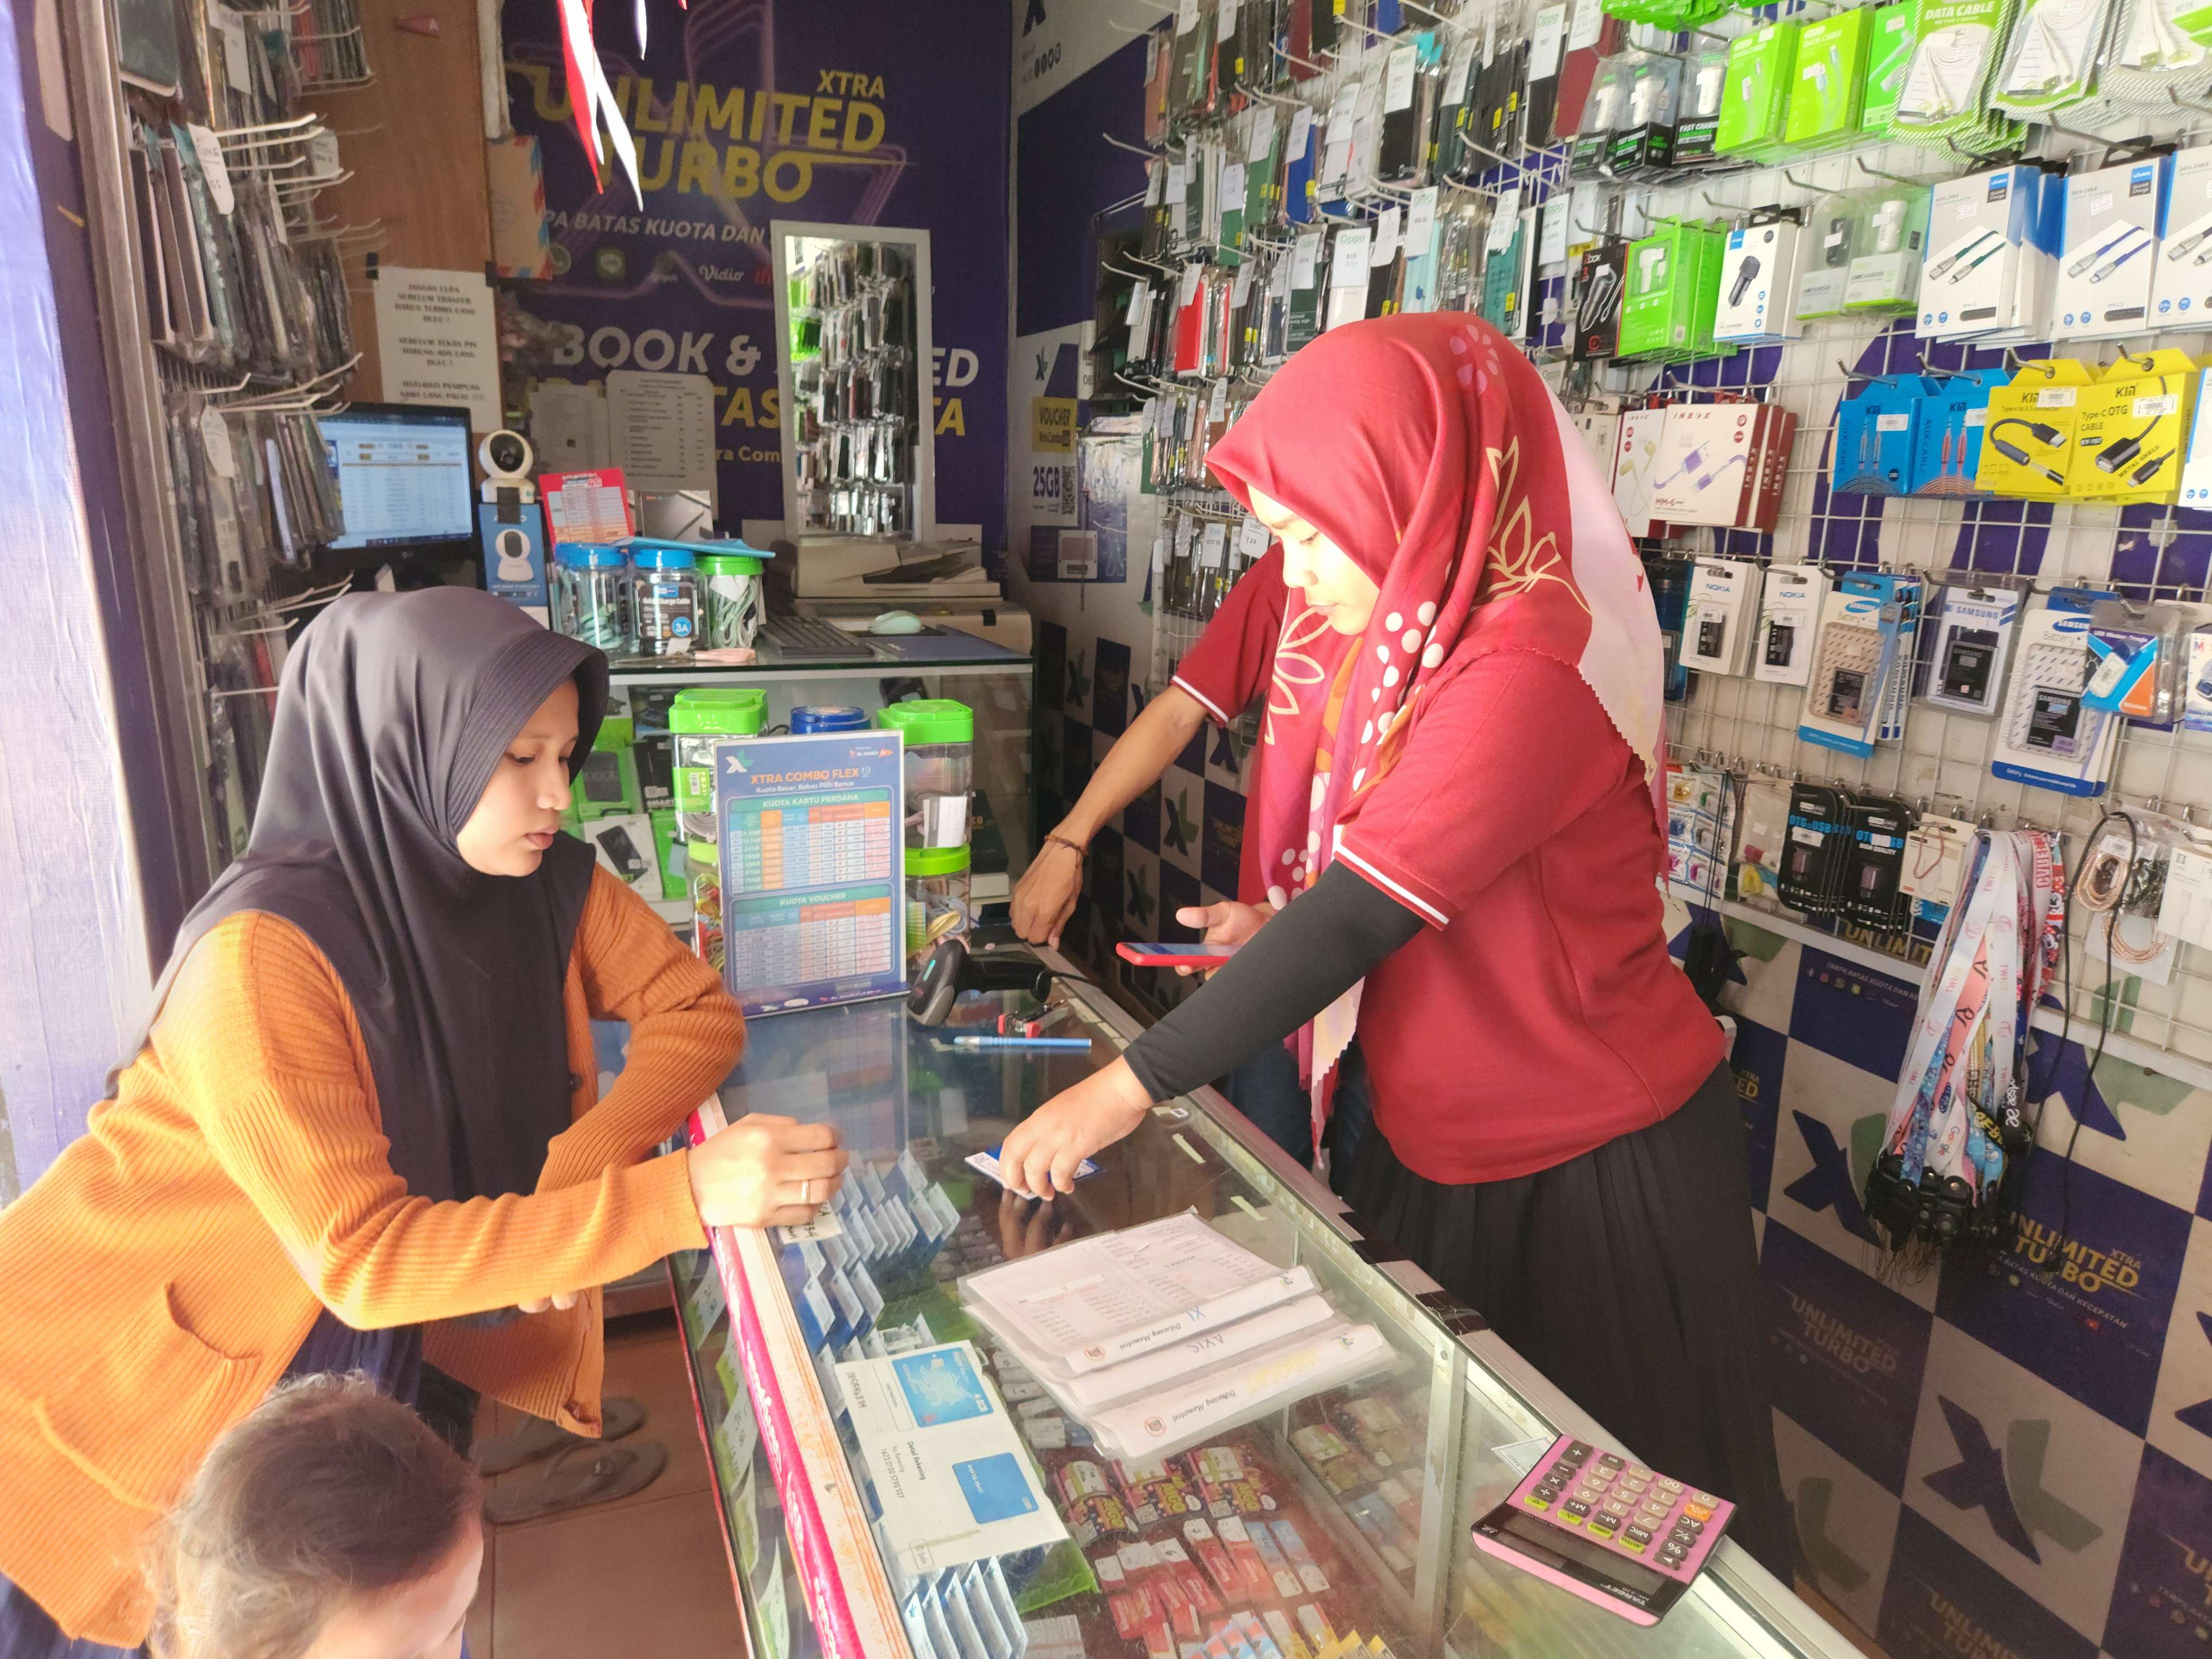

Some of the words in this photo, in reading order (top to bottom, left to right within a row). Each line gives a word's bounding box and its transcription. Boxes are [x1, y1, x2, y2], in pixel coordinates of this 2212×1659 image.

[1924, 8, 1956, 21] DATA
[1956, 2, 1994, 16] CABLE
[1803, 36, 1821, 48] DATA
[1821, 29, 1842, 42] CABLE
[818, 69, 885, 100] XTRA
[510, 62, 886, 153] ULIMITED
[574, 211, 640, 235] BATAS
[645, 219, 716, 240] KUOTA
[722, 224, 766, 243] DAN
[1341, 234, 1365, 244] Oppo
[726, 335, 761, 376] &
[1039, 407, 1072, 426] VOUCHER
[2082, 409, 2107, 421] Type-C
[2108, 405, 2128, 416] OTG
[2081, 421, 2104, 432] CABLE
[1033, 466, 1061, 499] 25GB
[1706, 583, 1731, 593] NOKIA
[1779, 590, 1806, 599] NOKIA
[1956, 606, 1999, 620] SAMSUNG
[676, 623, 689, 632] 3A
[750, 774, 783, 785] XTRA
[786, 769, 830, 782] COMBO
[832, 767, 860, 779] FLEX
[756, 786, 776, 794] Kuota
[777, 785, 797, 793] Besar,
[763, 799, 790, 808] KUOTA
[792, 796, 820, 806] KARTU
[821, 794, 859, 803] PERDANA
[780, 897, 807, 906] KUOTA
[808, 893, 846, 903] VOUCHER
[1937, 1126, 1960, 1156] Google
[2015, 1236, 2101, 1293] TUBO
[1152, 1322, 1181, 1337] Dilarang
[1119, 1332, 1150, 1351] Memotret
[1186, 1333, 1224, 1354] AXIS
[1206, 1388, 1237, 1406] Dilarang
[1172, 1402, 1204, 1423] Memotret
[894, 1452, 905, 1473] Rekening
[906, 1441, 917, 1458] Detail
[914, 1456, 927, 1481] Rekening
[880, 1448, 890, 1462] 1673
[886, 1462, 894, 1474] 0100
[890, 1474, 901, 1488] 5790
[896, 1487, 905, 1499] 507
[1600, 1466, 1609, 1475] 3
[1591, 1477, 1600, 1487] 6
[1629, 1478, 1639, 1488] 2
[1664, 1478, 1680, 1489] 00
[1581, 1489, 1591, 1498] 9
[1620, 1490, 1629, 1499] 5
[1701, 1493, 1711, 1502] 0
[1569, 1500, 1586, 1513] M+
[1612, 1502, 1622, 1512] 8
[1651, 1502, 1661, 1512] 4
[1600, 1514, 1617, 1525] M-
[1642, 1516, 1651, 1525] 7
[1681, 1516, 1701, 1528] AC
[1589, 1522, 1611, 1536] CORRECT
[1629, 1525, 1649, 1539] MRC
[1621, 1537, 1642, 1550] AUTO
[1604, 1581, 1646, 1606] TARGET
